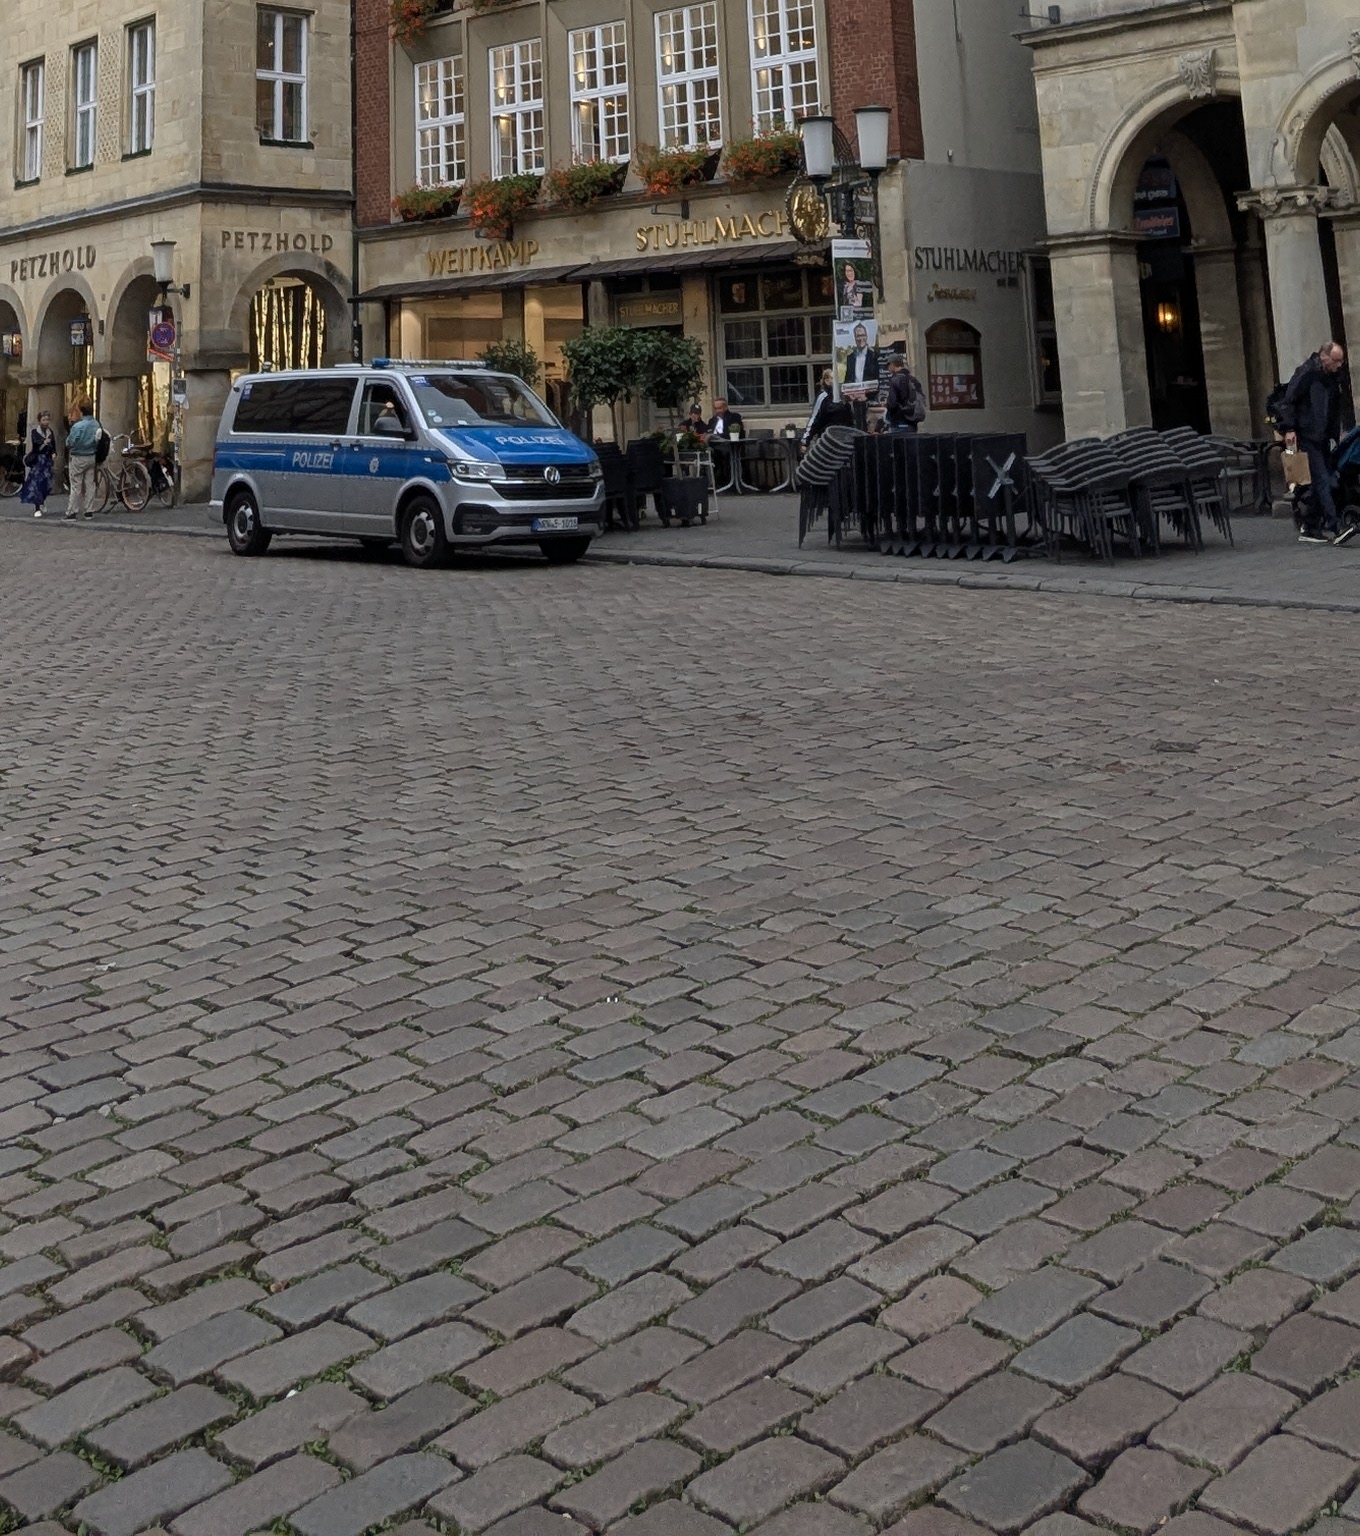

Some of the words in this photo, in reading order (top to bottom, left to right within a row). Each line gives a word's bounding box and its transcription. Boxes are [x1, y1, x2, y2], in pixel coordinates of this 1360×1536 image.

[221, 230, 333, 252] PETZHOLD
[636, 210, 790, 252] STUHLMACH
[11, 245, 96, 283] PETZHOLD
[426, 239, 538, 276] WEITKAMP
[914, 246, 1028, 273] STUHLMACHER
[495, 435, 566, 446] POLIZEI
[292, 451, 334, 469] POLIZEI
